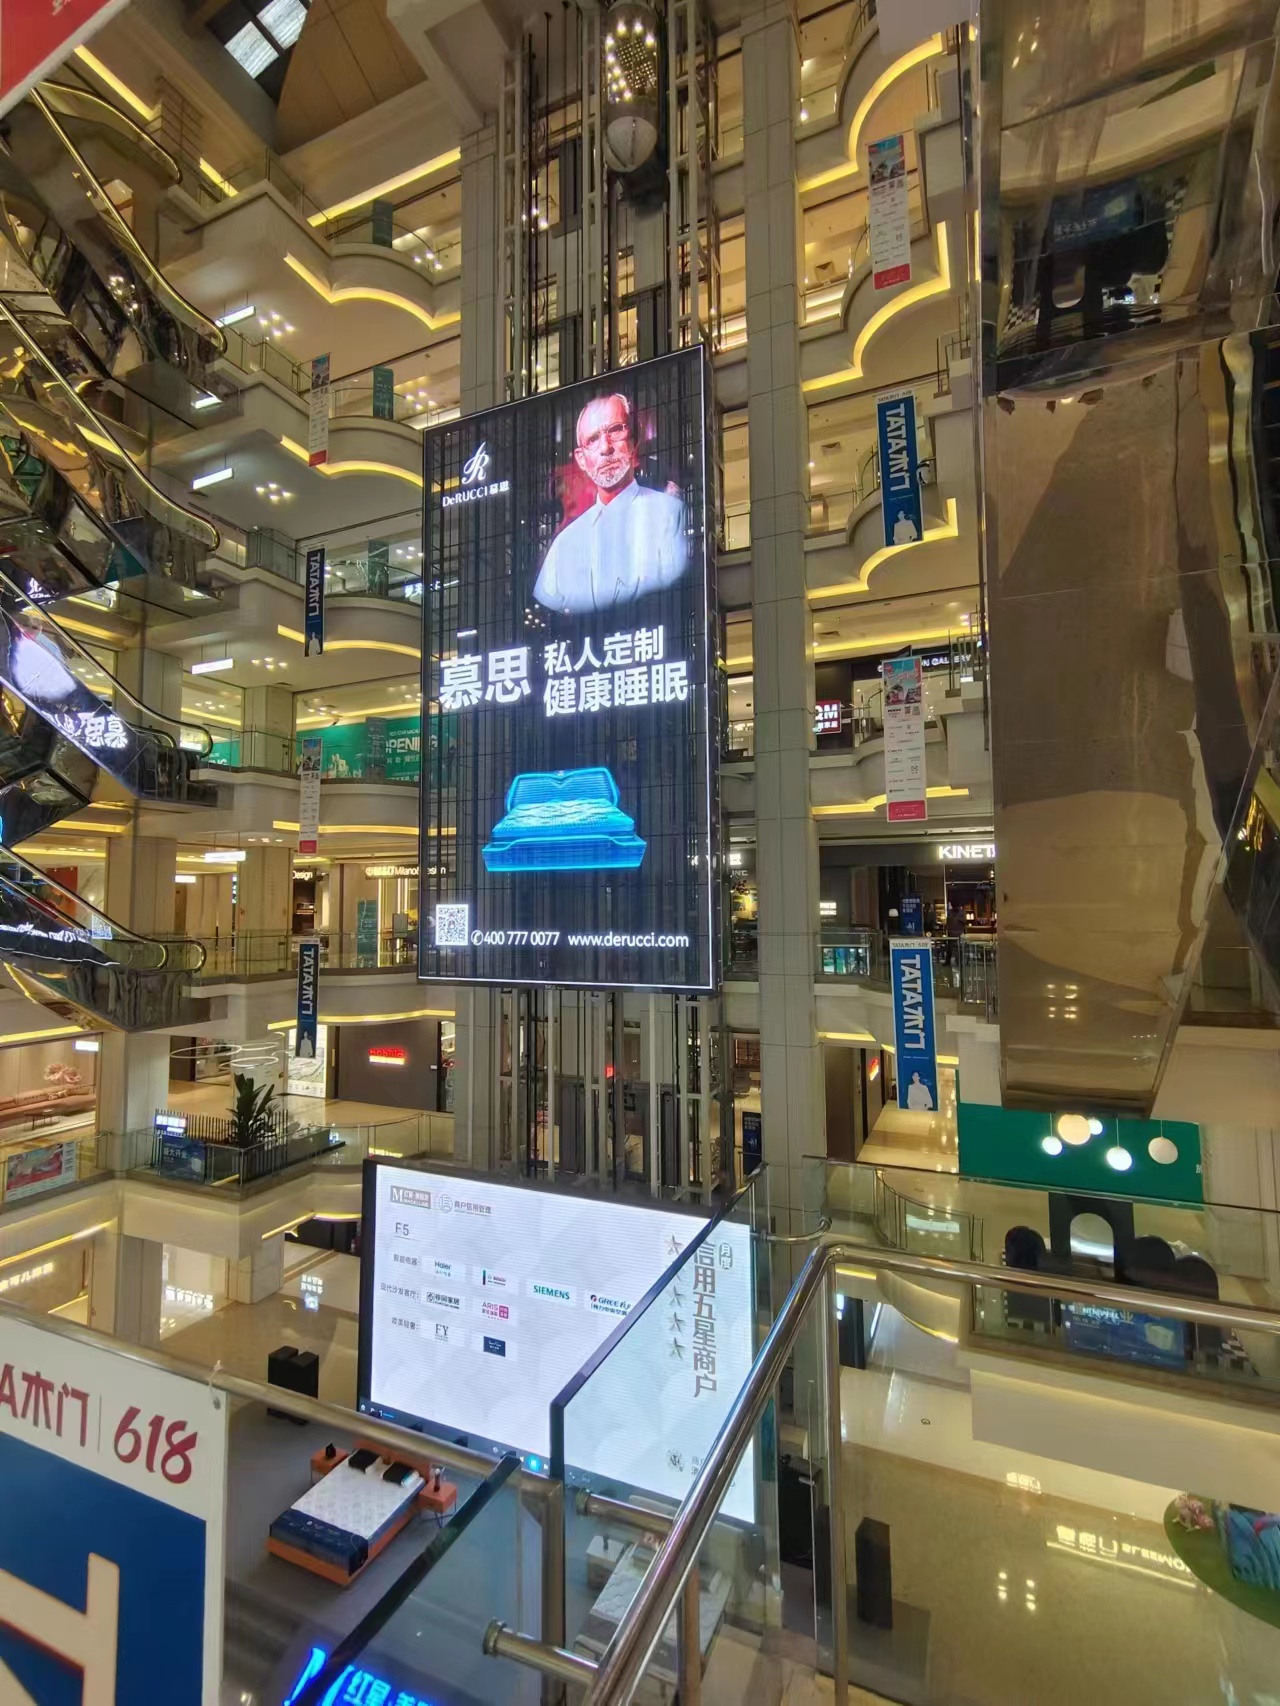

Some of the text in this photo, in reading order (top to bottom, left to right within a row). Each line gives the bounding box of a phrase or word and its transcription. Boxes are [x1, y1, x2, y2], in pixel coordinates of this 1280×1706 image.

[442, 486, 488, 507] DeRUCCI
[544, 625, 664, 676] 私人定制
[439, 647, 531, 711] 慕思
[543, 661, 688, 717] 健康睡眠
[484, 931, 689, 947] 400 777 0077 www.derucci.com
[395, 1222, 410, 1236] F5
[481, 1301, 499, 1311] ARIS
[533, 1285, 570, 1300] SIEMENS
[693, 1241, 717, 1397] 信用五星商户
[114, 1405, 199, 1485] 618
